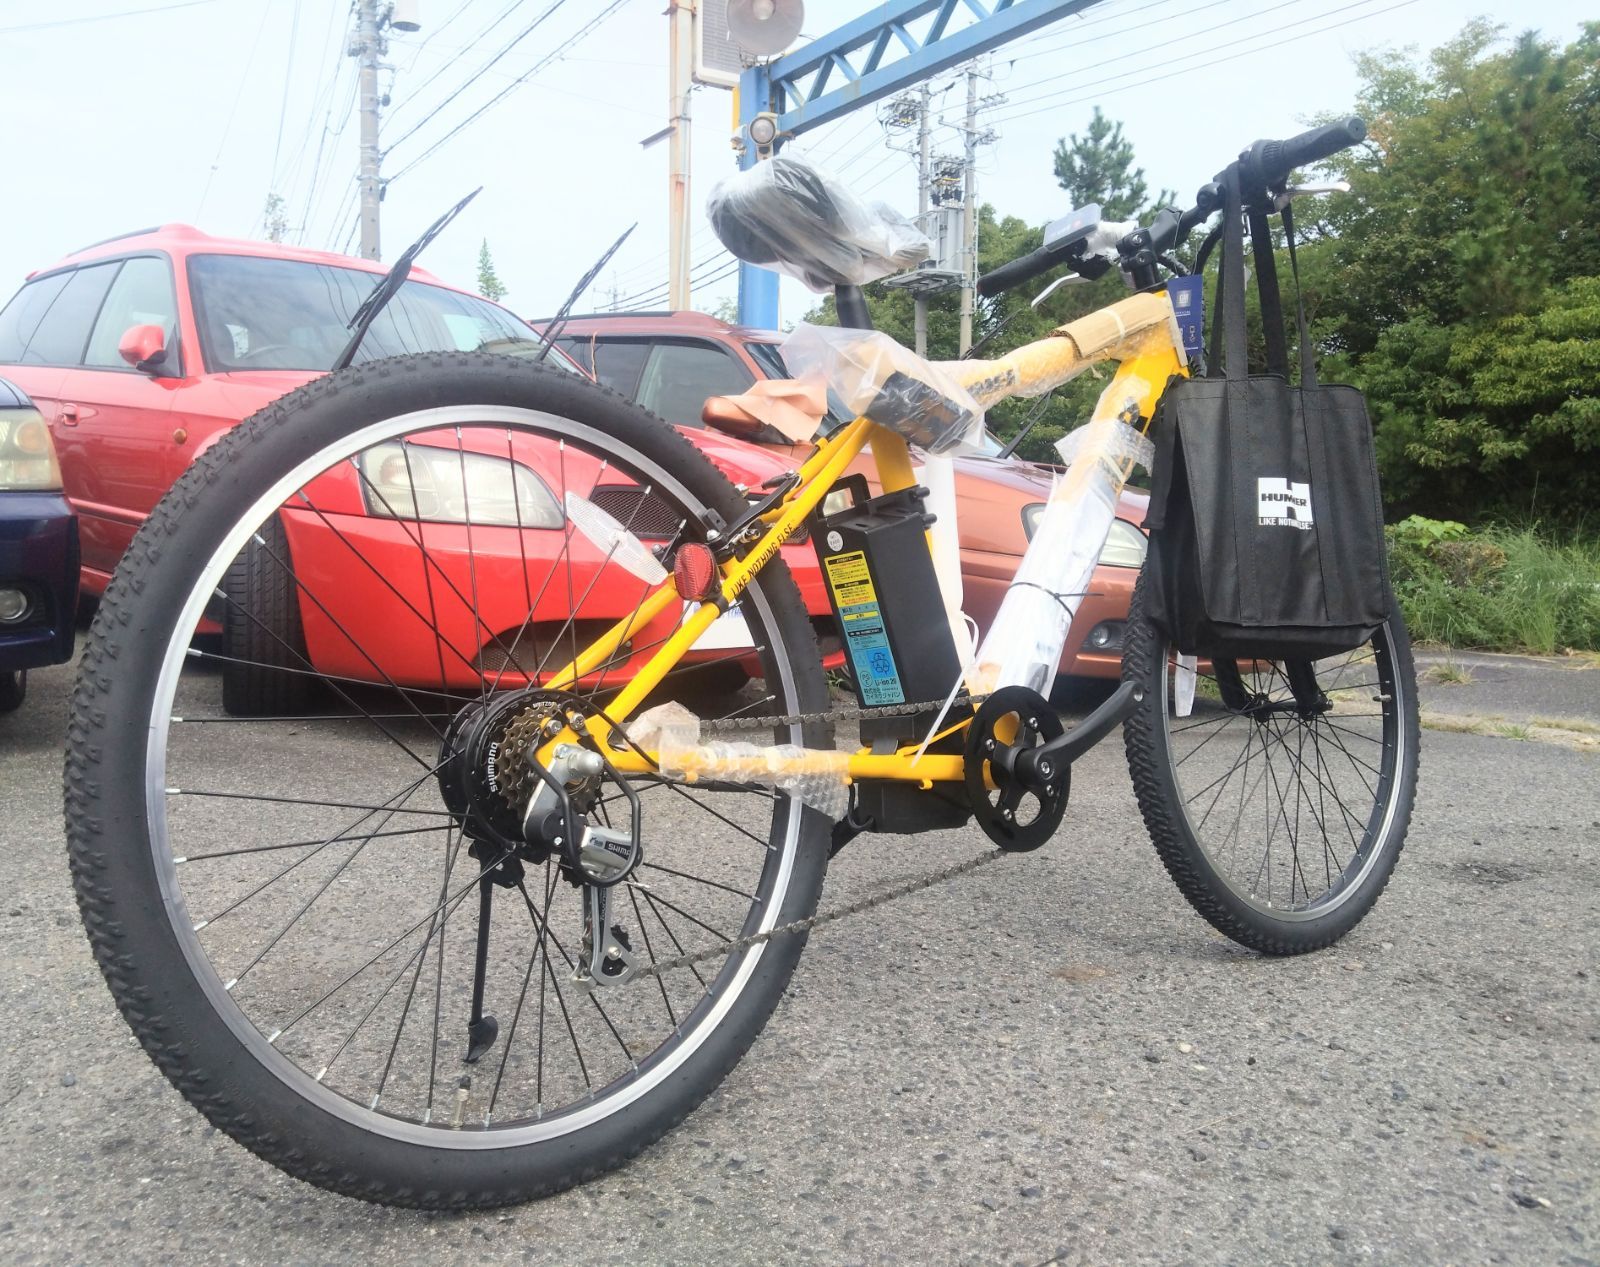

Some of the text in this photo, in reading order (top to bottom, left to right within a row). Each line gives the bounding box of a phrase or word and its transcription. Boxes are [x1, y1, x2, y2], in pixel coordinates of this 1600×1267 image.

[1261, 493, 1306, 506] HUMER
[1259, 517, 1277, 526] LIKE
[731, 575, 748, 597] LIKE
[748, 542, 779, 578] NOTHING
[487, 742, 498, 793] SHIMANO
[608, 843, 631, 857] SHIMA
